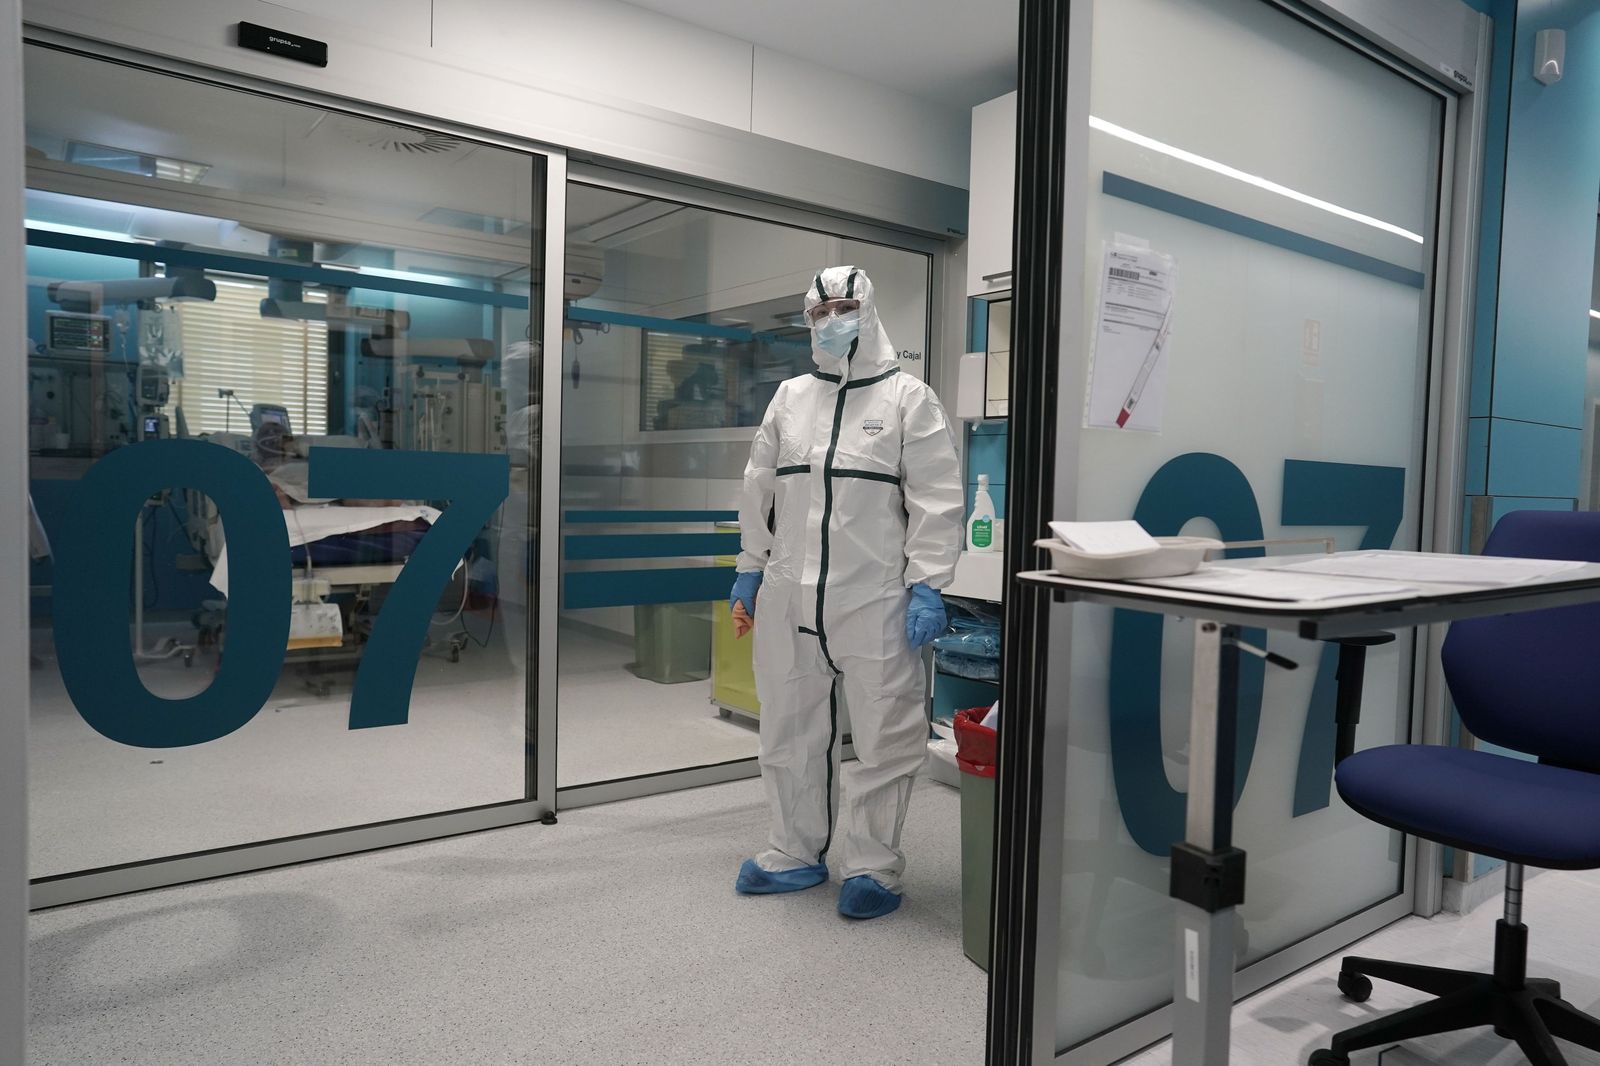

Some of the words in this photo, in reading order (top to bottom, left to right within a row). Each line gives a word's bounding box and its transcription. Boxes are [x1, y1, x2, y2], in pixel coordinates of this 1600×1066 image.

[902, 350, 922, 361] Cajal
[52, 438, 510, 749] 07
[1109, 452, 1406, 857] 07
